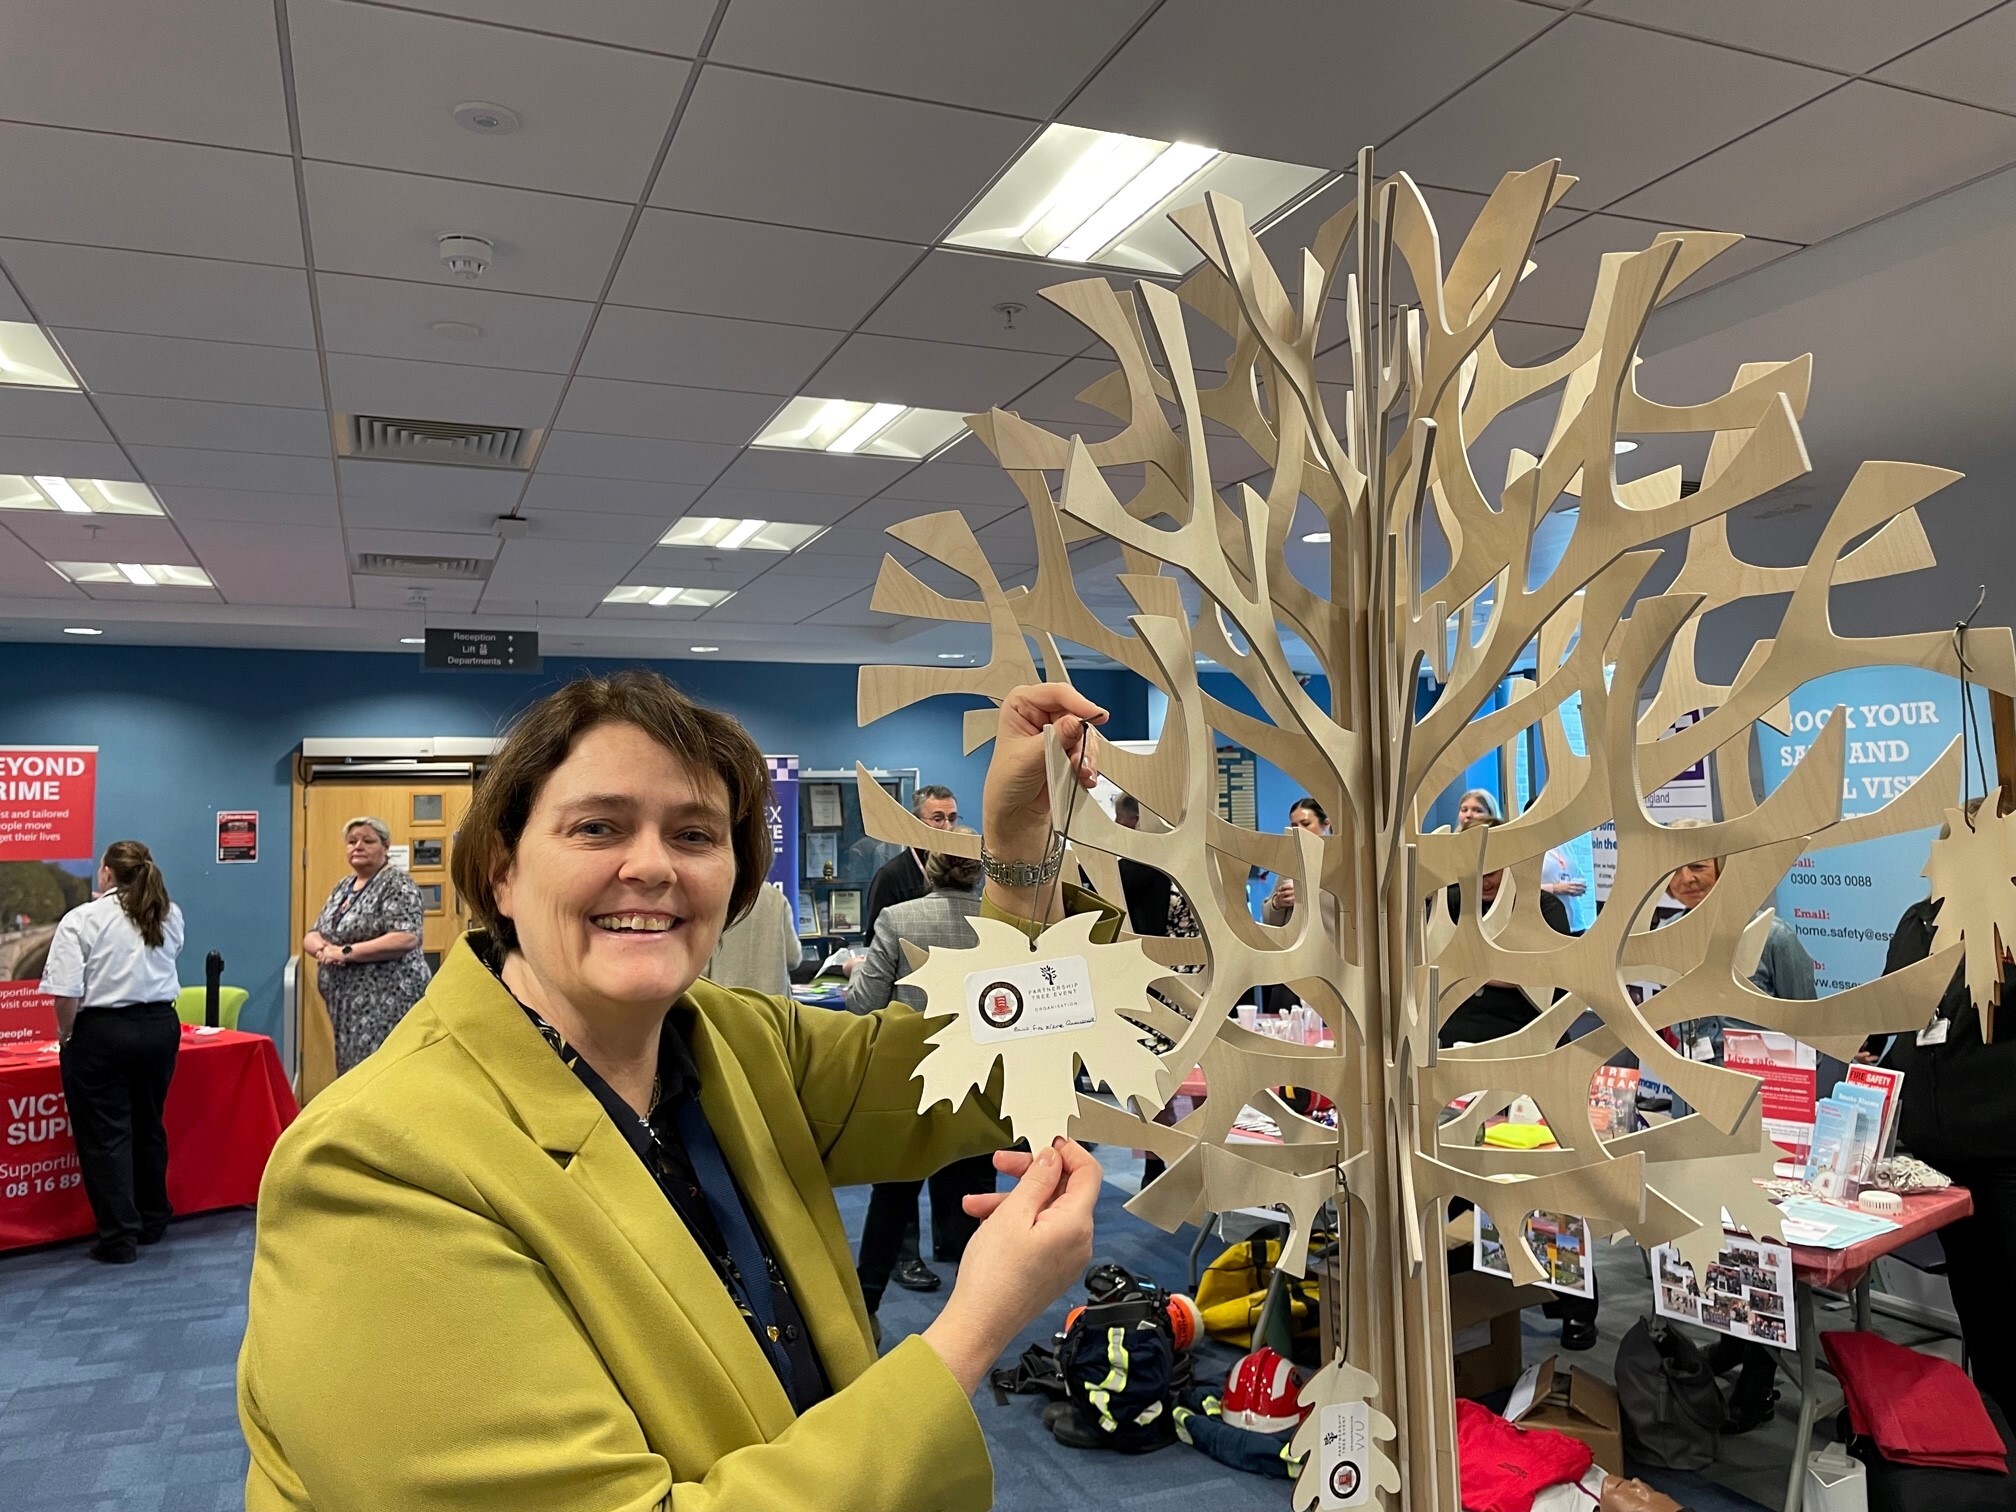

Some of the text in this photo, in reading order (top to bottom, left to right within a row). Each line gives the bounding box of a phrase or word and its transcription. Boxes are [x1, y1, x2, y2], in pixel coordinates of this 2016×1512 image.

[453, 632, 496, 643] Reception
[462, 645, 476, 654] Lift
[447, 655, 502, 666] Departments
[1789, 701, 1940, 733] OOK YOUR
[1849, 740, 1910, 764] AND
[11, 809, 30, 819] and
[32, 809, 69, 819] tailored
[0, 821, 52, 832] ople move
[15, 832, 38, 842] their
[39, 832, 61, 842] lives
[1790, 873, 1872, 887] 0300 303 0088
[1794, 908, 1830, 920] Email:
[1028, 982, 1079, 995] PARTNERSHIP
[1053, 989, 1077, 998] EVENT
[1, 999, 20, 1009] visit
[22, 1000, 39, 1008] our
[1034, 1002, 1078, 1012] ORGANISATION
[1599, 1066, 1628, 1078] IRE
[1596, 1075, 1637, 1090] REAK
[1866, 1073, 1891, 1086] SAFETY
[6, 1173, 81, 1198] 08 16 89
